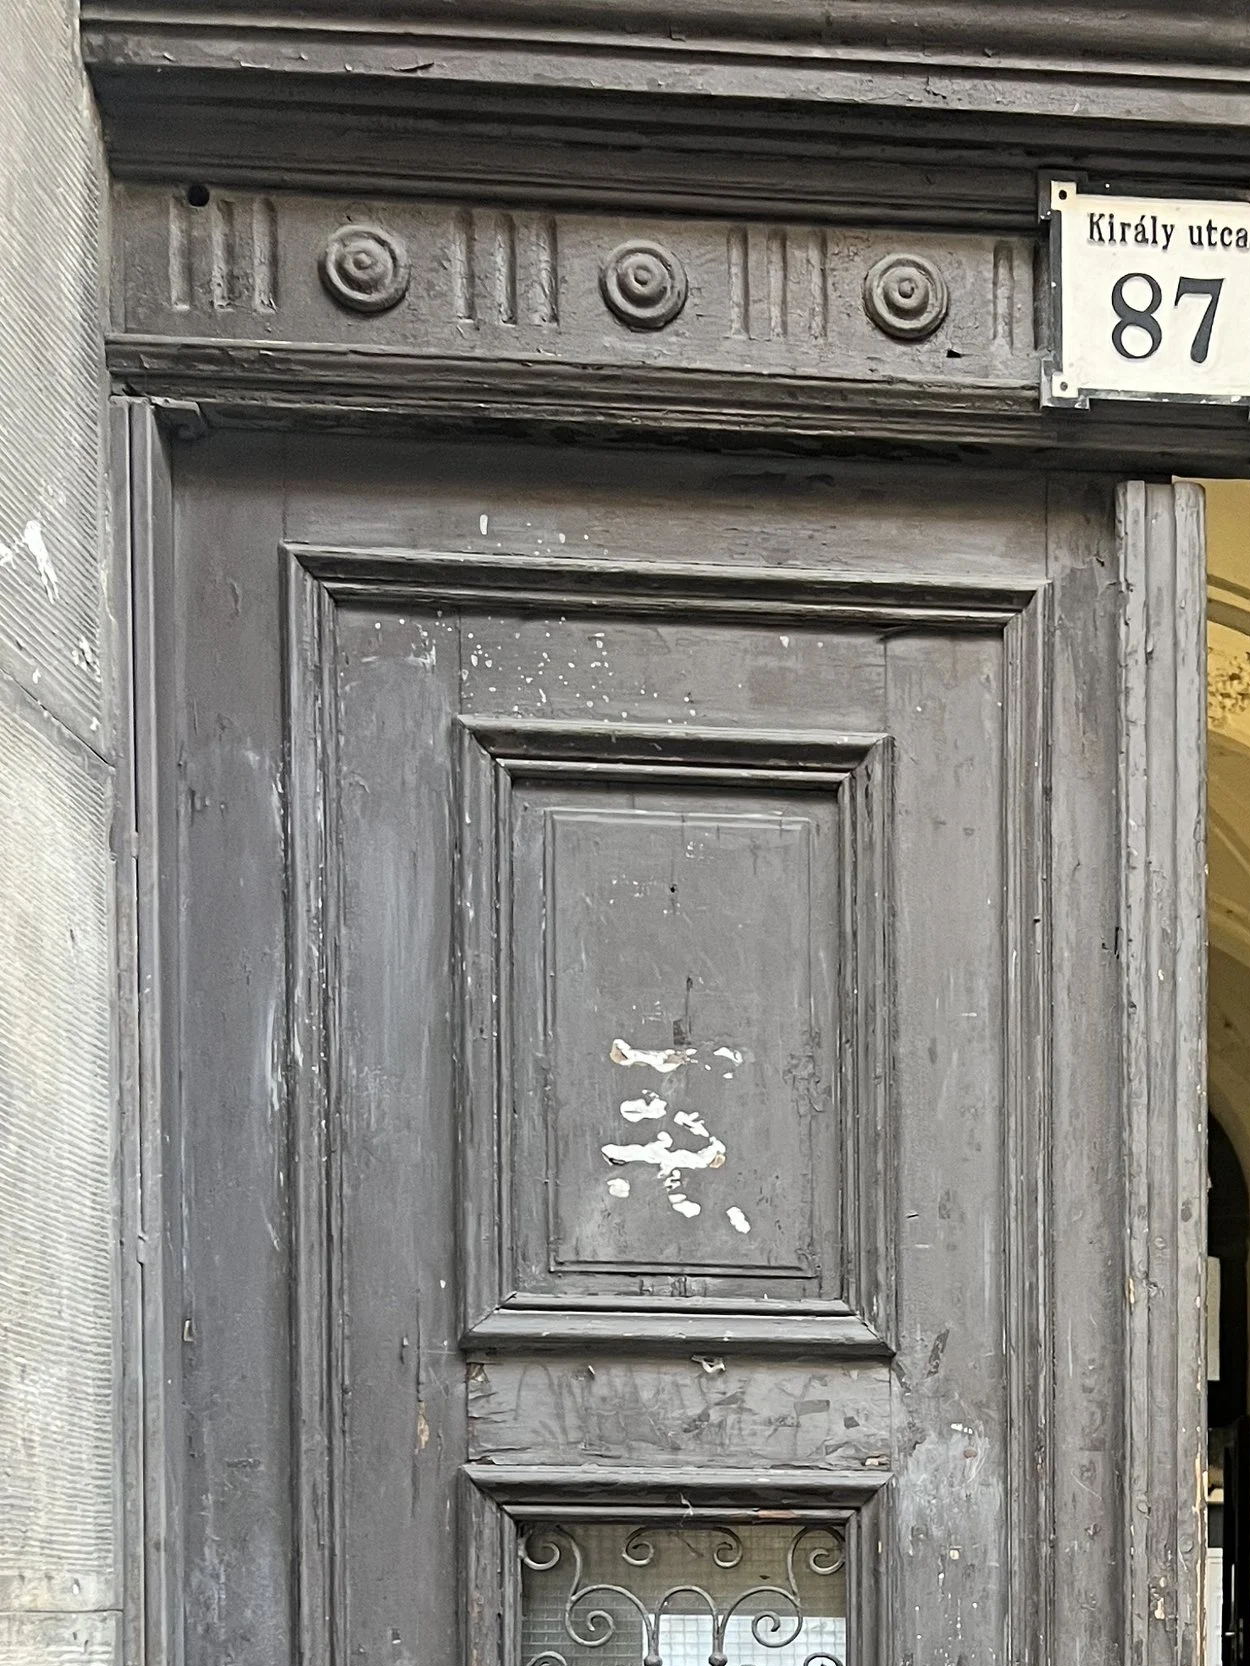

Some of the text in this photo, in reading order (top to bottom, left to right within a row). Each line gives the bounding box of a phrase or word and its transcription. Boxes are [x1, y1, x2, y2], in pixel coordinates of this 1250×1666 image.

[1087, 211, 1250, 250] Király utca
[1111, 272, 1225, 364] 87
